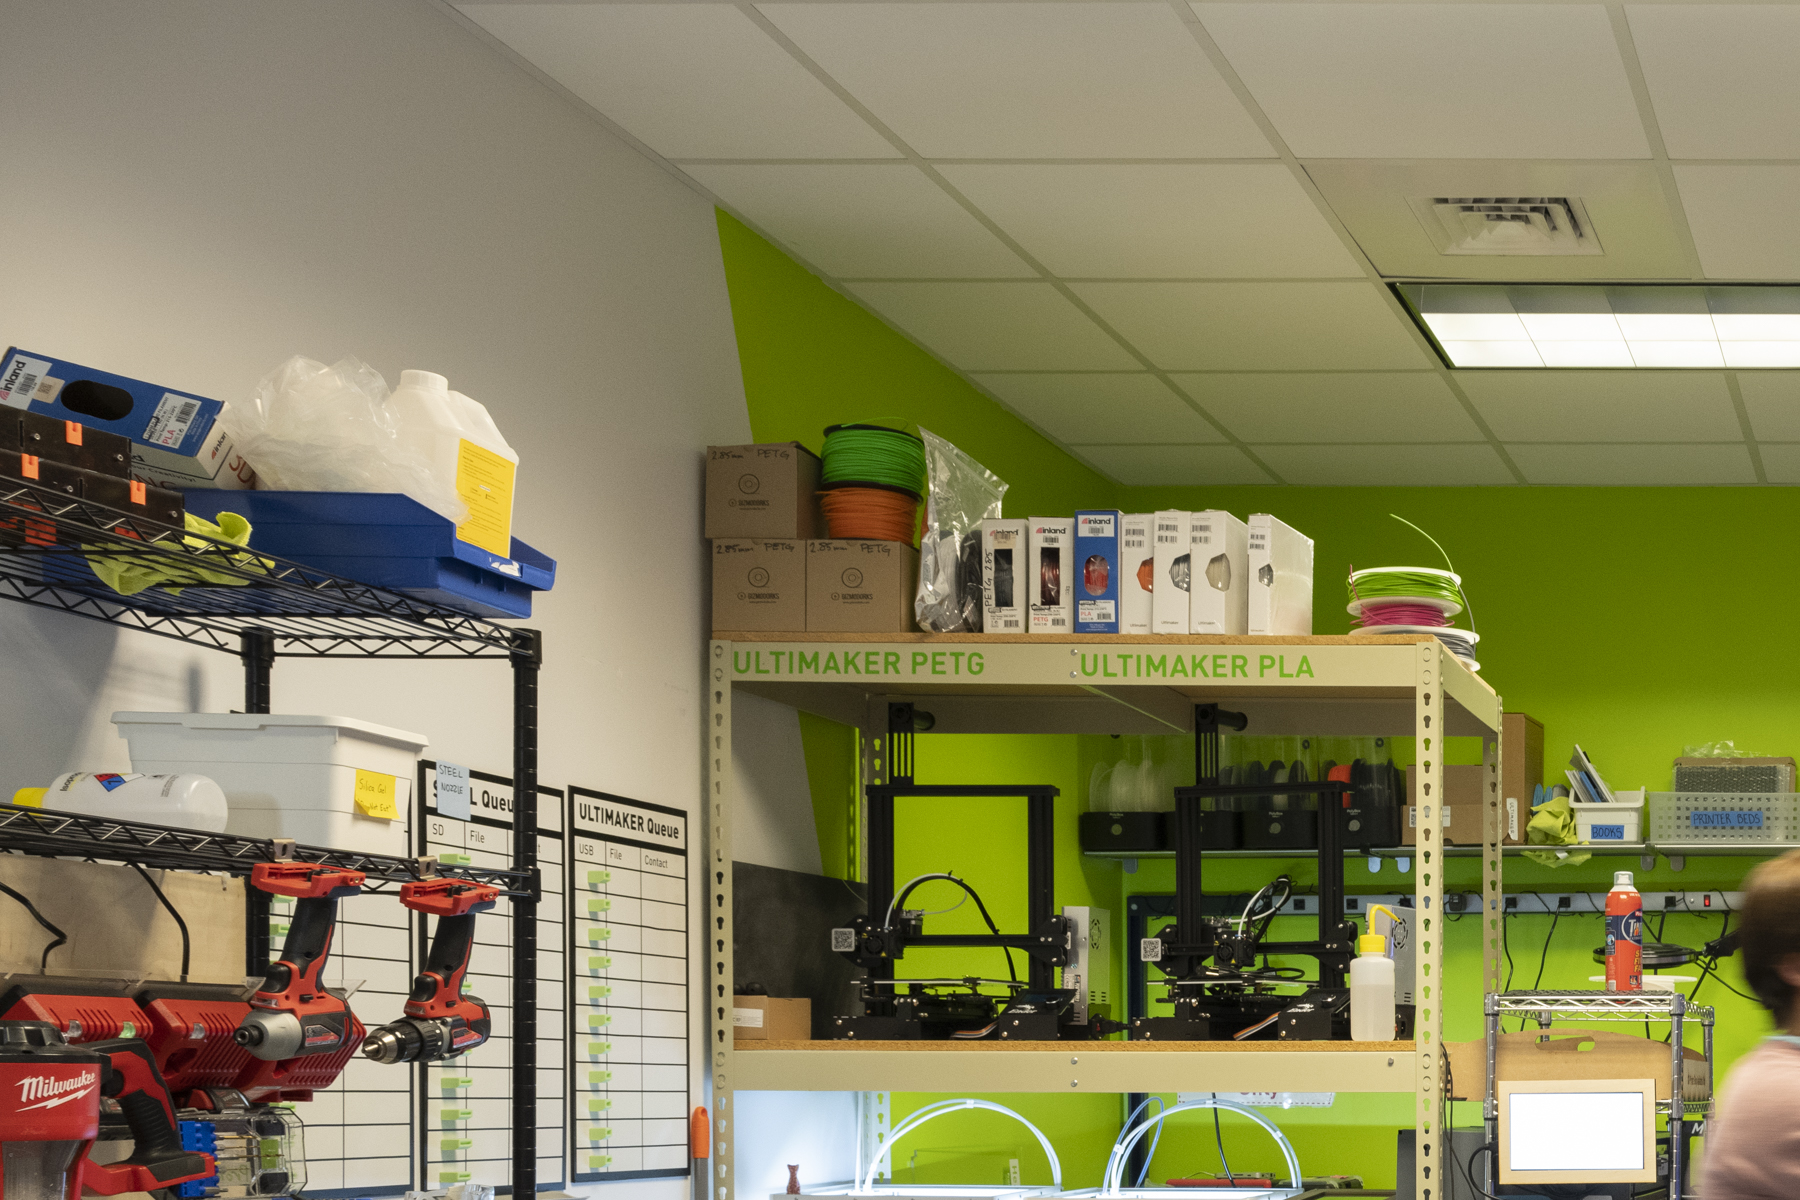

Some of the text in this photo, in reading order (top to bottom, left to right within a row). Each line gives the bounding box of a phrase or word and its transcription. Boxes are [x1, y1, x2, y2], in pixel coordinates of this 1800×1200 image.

[3, 361, 26, 393] inland
[162, 430, 176, 444] PLA
[757, 449, 790, 460] PETG
[1042, 527, 1066, 535] inland
[764, 543, 795, 553] PETG
[860, 544, 890, 558] PETG
[985, 578, 993, 607] PETG
[733, 651, 985, 676] ULTIMAKER PETG
[1080, 654, 1315, 679] ULTIMAKER PLA
[439, 764, 463, 778] STEEL
[377, 783, 387, 794] Gel
[441, 782, 463, 795] NOZZLE
[482, 790, 514, 812] Queu
[579, 802, 679, 840] ULTIMAKER Queue
[1693, 812, 1762, 826] PRINTER BEDS
[432, 823, 444, 836] SD
[1592, 826, 1623, 839] BOOKS
[470, 831, 485, 844] File
[579, 843, 594, 856] USB
[609, 848, 622, 861] File
[644, 855, 668, 869] Contact
[16, 1071, 95, 1103] Milwaukee
